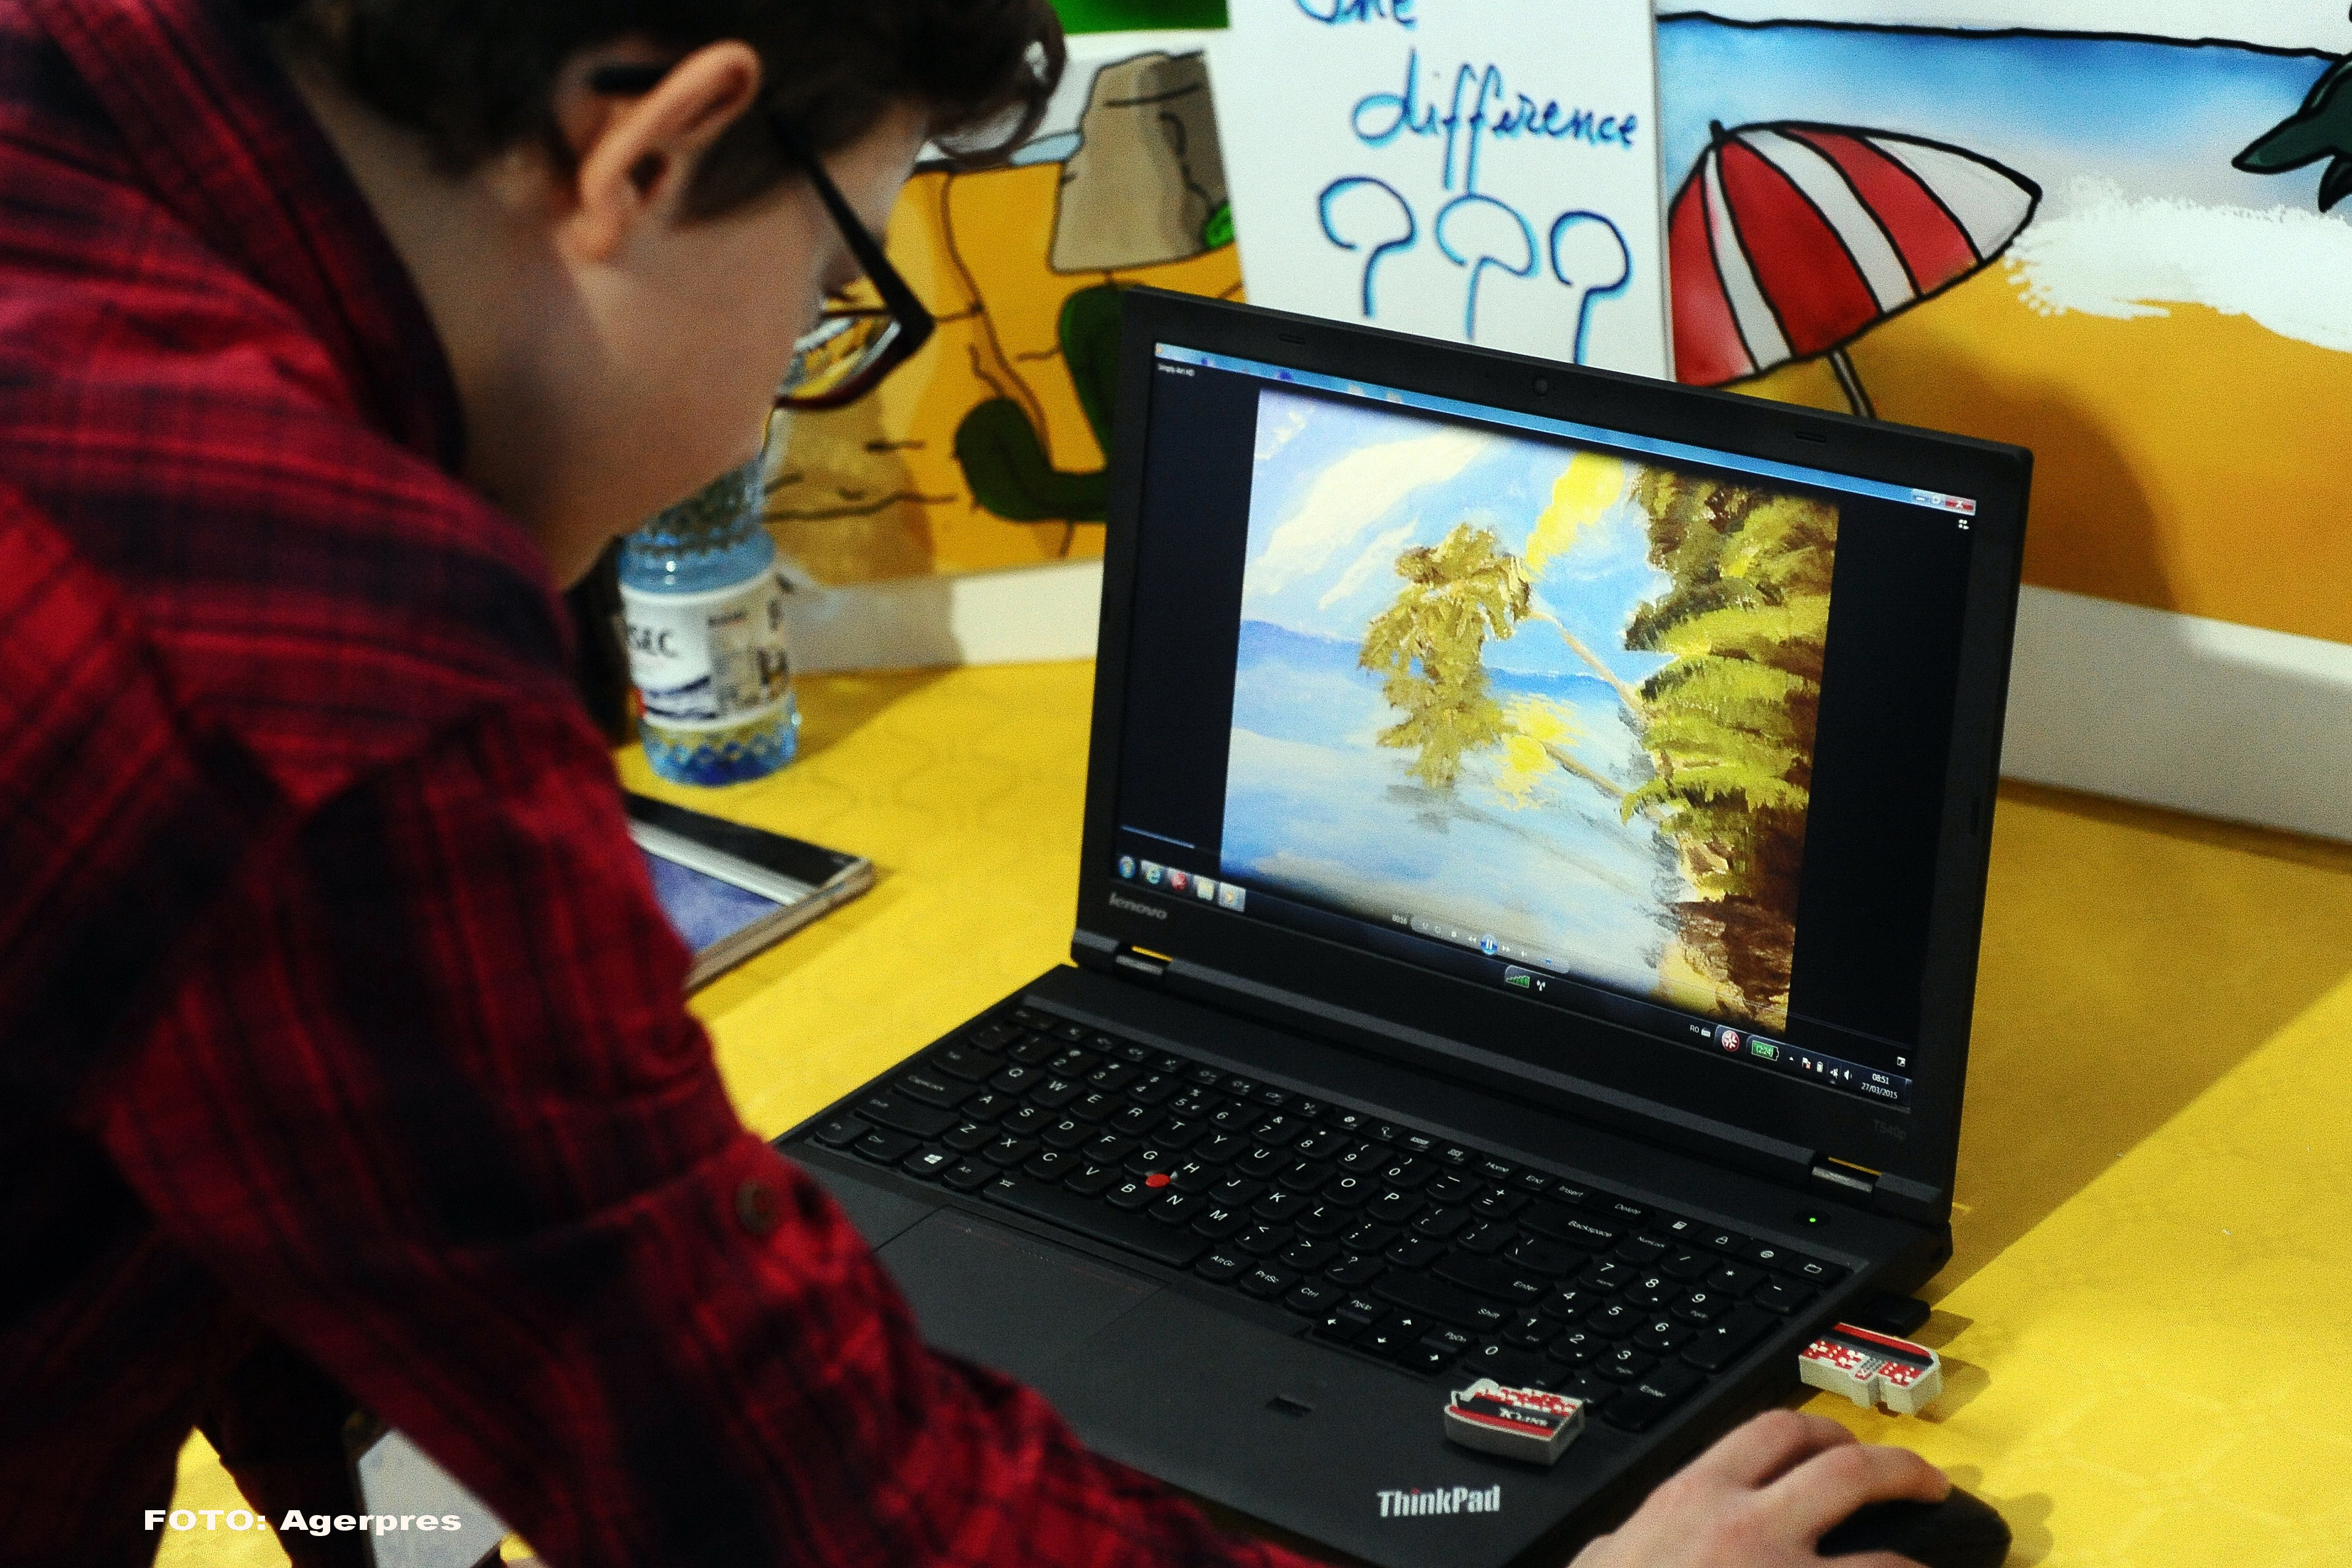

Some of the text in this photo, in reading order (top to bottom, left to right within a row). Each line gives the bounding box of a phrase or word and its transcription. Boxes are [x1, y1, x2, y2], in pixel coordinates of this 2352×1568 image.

[1350, 46, 1637, 193] difference
[1109, 892, 1168, 920] lenovo
[1690, 1024, 1700, 1034] RO
[1872, 1073, 1889, 1085] 08:51
[1050, 1081, 1067, 1091] W
[1861, 1082, 1898, 1099] 27/03/2015
[1087, 1095, 1101, 1103] E
[1128, 1108, 1142, 1117] R
[960, 1124, 976, 1133] Z
[1059, 1121, 1074, 1130] D
[1001, 1138, 1016, 1147] X
[1143, 1151, 1158, 1160] G
[1254, 1149, 1269, 1158] U
[1184, 1163, 1199, 1173] H
[1526, 1175, 1543, 1184] End
[1121, 1184, 1136, 1192] B
[1167, 1195, 1183, 1205] N
[1270, 1193, 1285, 1202] K
[1210, 1210, 1227, 1221] M
[1314, 1208, 1323, 1216] L
[1645, 1279, 1659, 1288] 8
[1692, 1294, 1706, 1302] 9
[1609, 1306, 1622, 1315] 5
[1655, 1323, 1669, 1331] 6
[1570, 1334, 1585, 1344] 2
[1617, 1350, 1631, 1359] 3
[1377, 1484, 1500, 1517] ThinkPad
